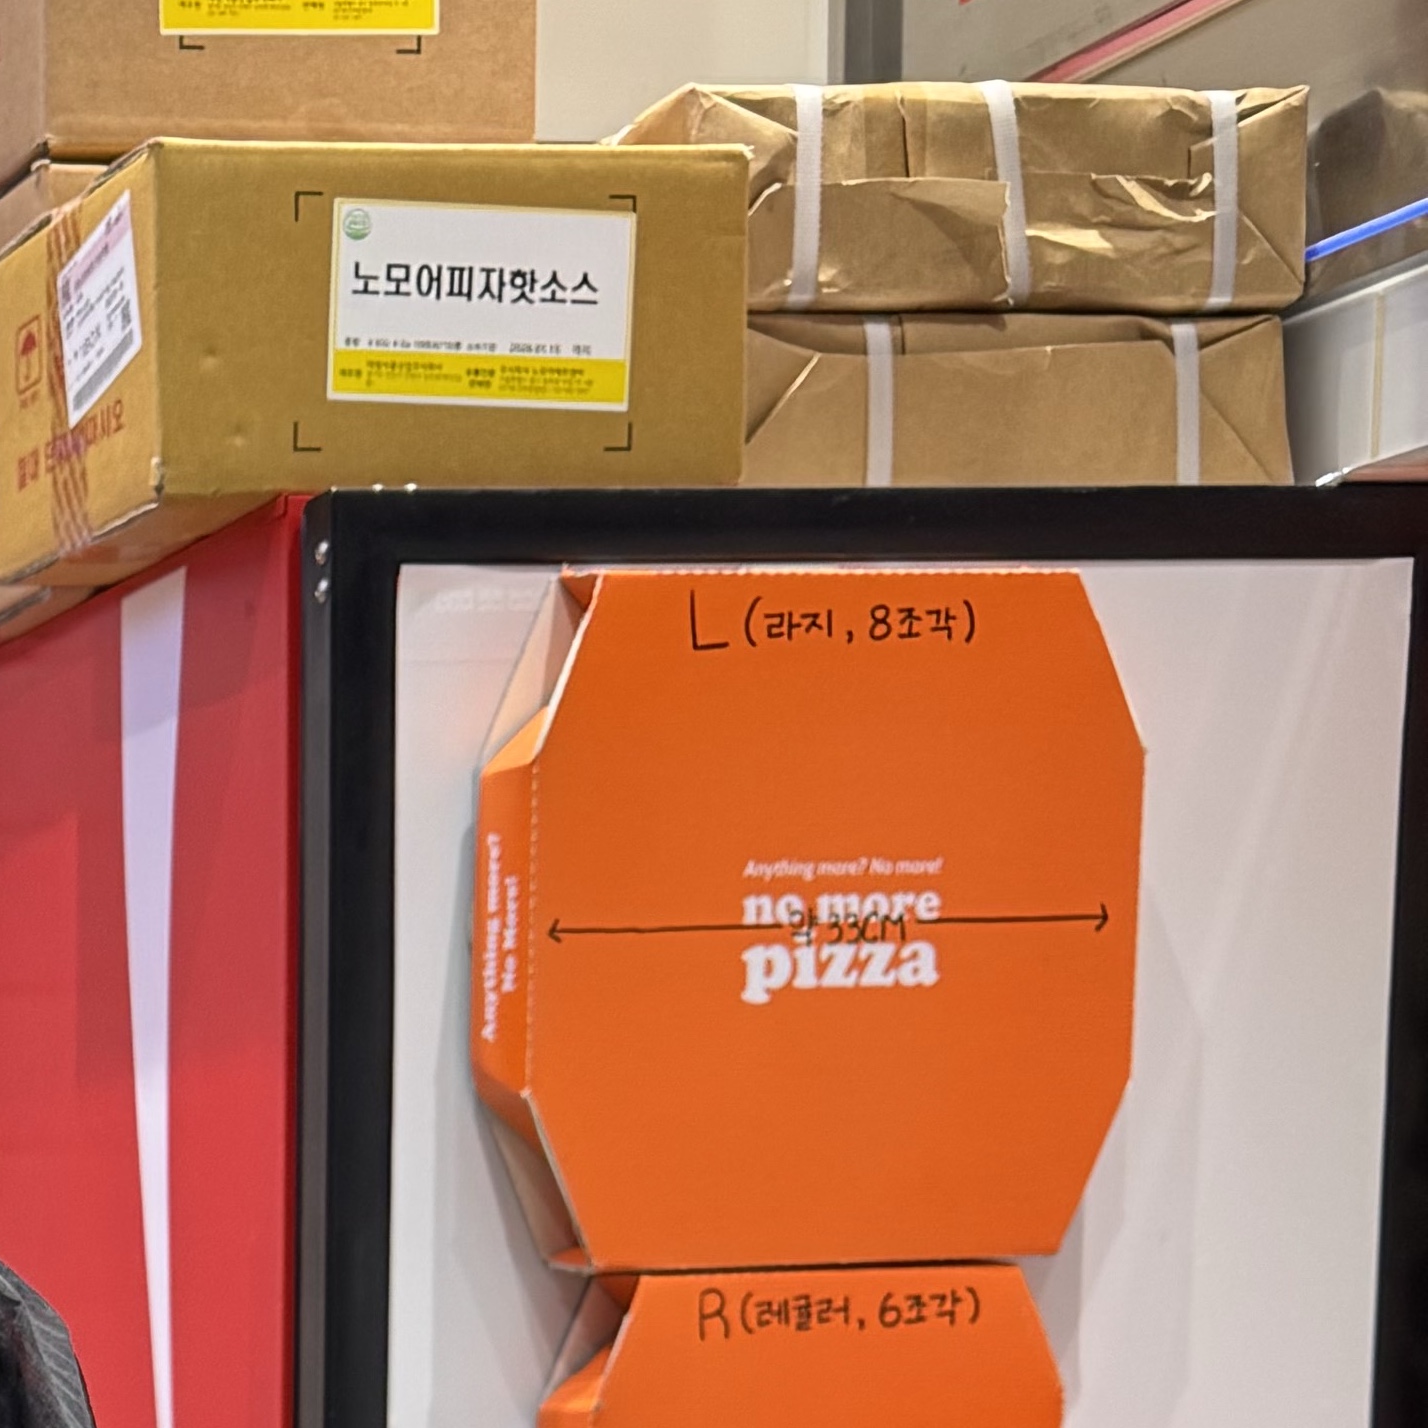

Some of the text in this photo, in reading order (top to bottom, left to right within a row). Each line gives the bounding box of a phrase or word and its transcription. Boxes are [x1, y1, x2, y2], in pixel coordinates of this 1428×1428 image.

[351, 261, 599, 306] 노모어피자핫소스
[690, 589, 730, 651] L
[743, 855, 944, 881] Anything more? No more!
[742, 889, 942, 926] no more
[826, 910, 907, 945] 33CM
[740, 931, 941, 1006] pizza
[698, 1287, 731, 1342] R
